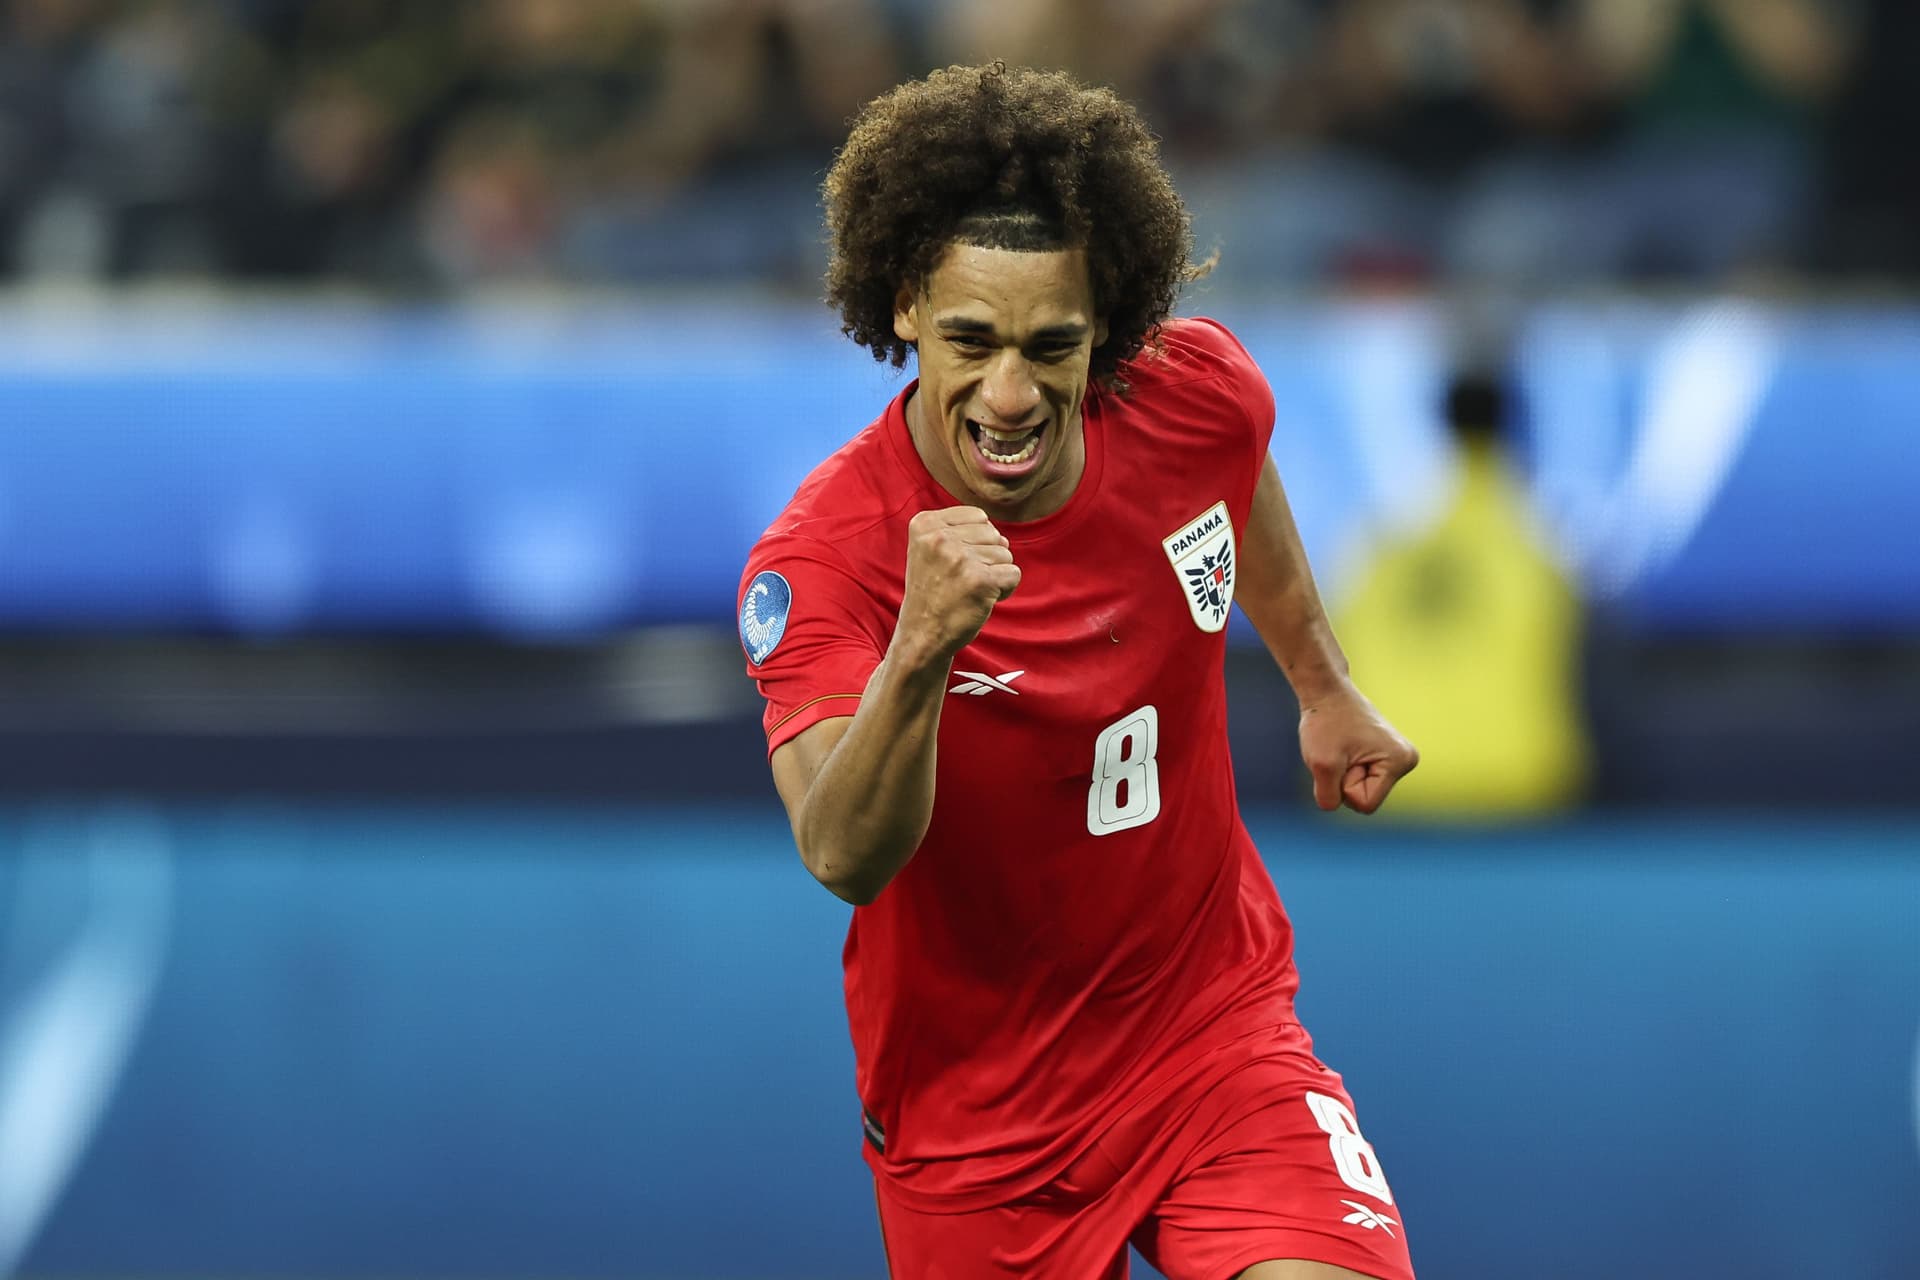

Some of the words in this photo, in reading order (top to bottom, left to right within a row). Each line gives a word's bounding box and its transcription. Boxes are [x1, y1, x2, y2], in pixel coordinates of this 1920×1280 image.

[1172, 512, 1223, 556] PANAMÁ
[1087, 705, 1160, 836] 8
[1305, 1091, 1393, 1206] 8
